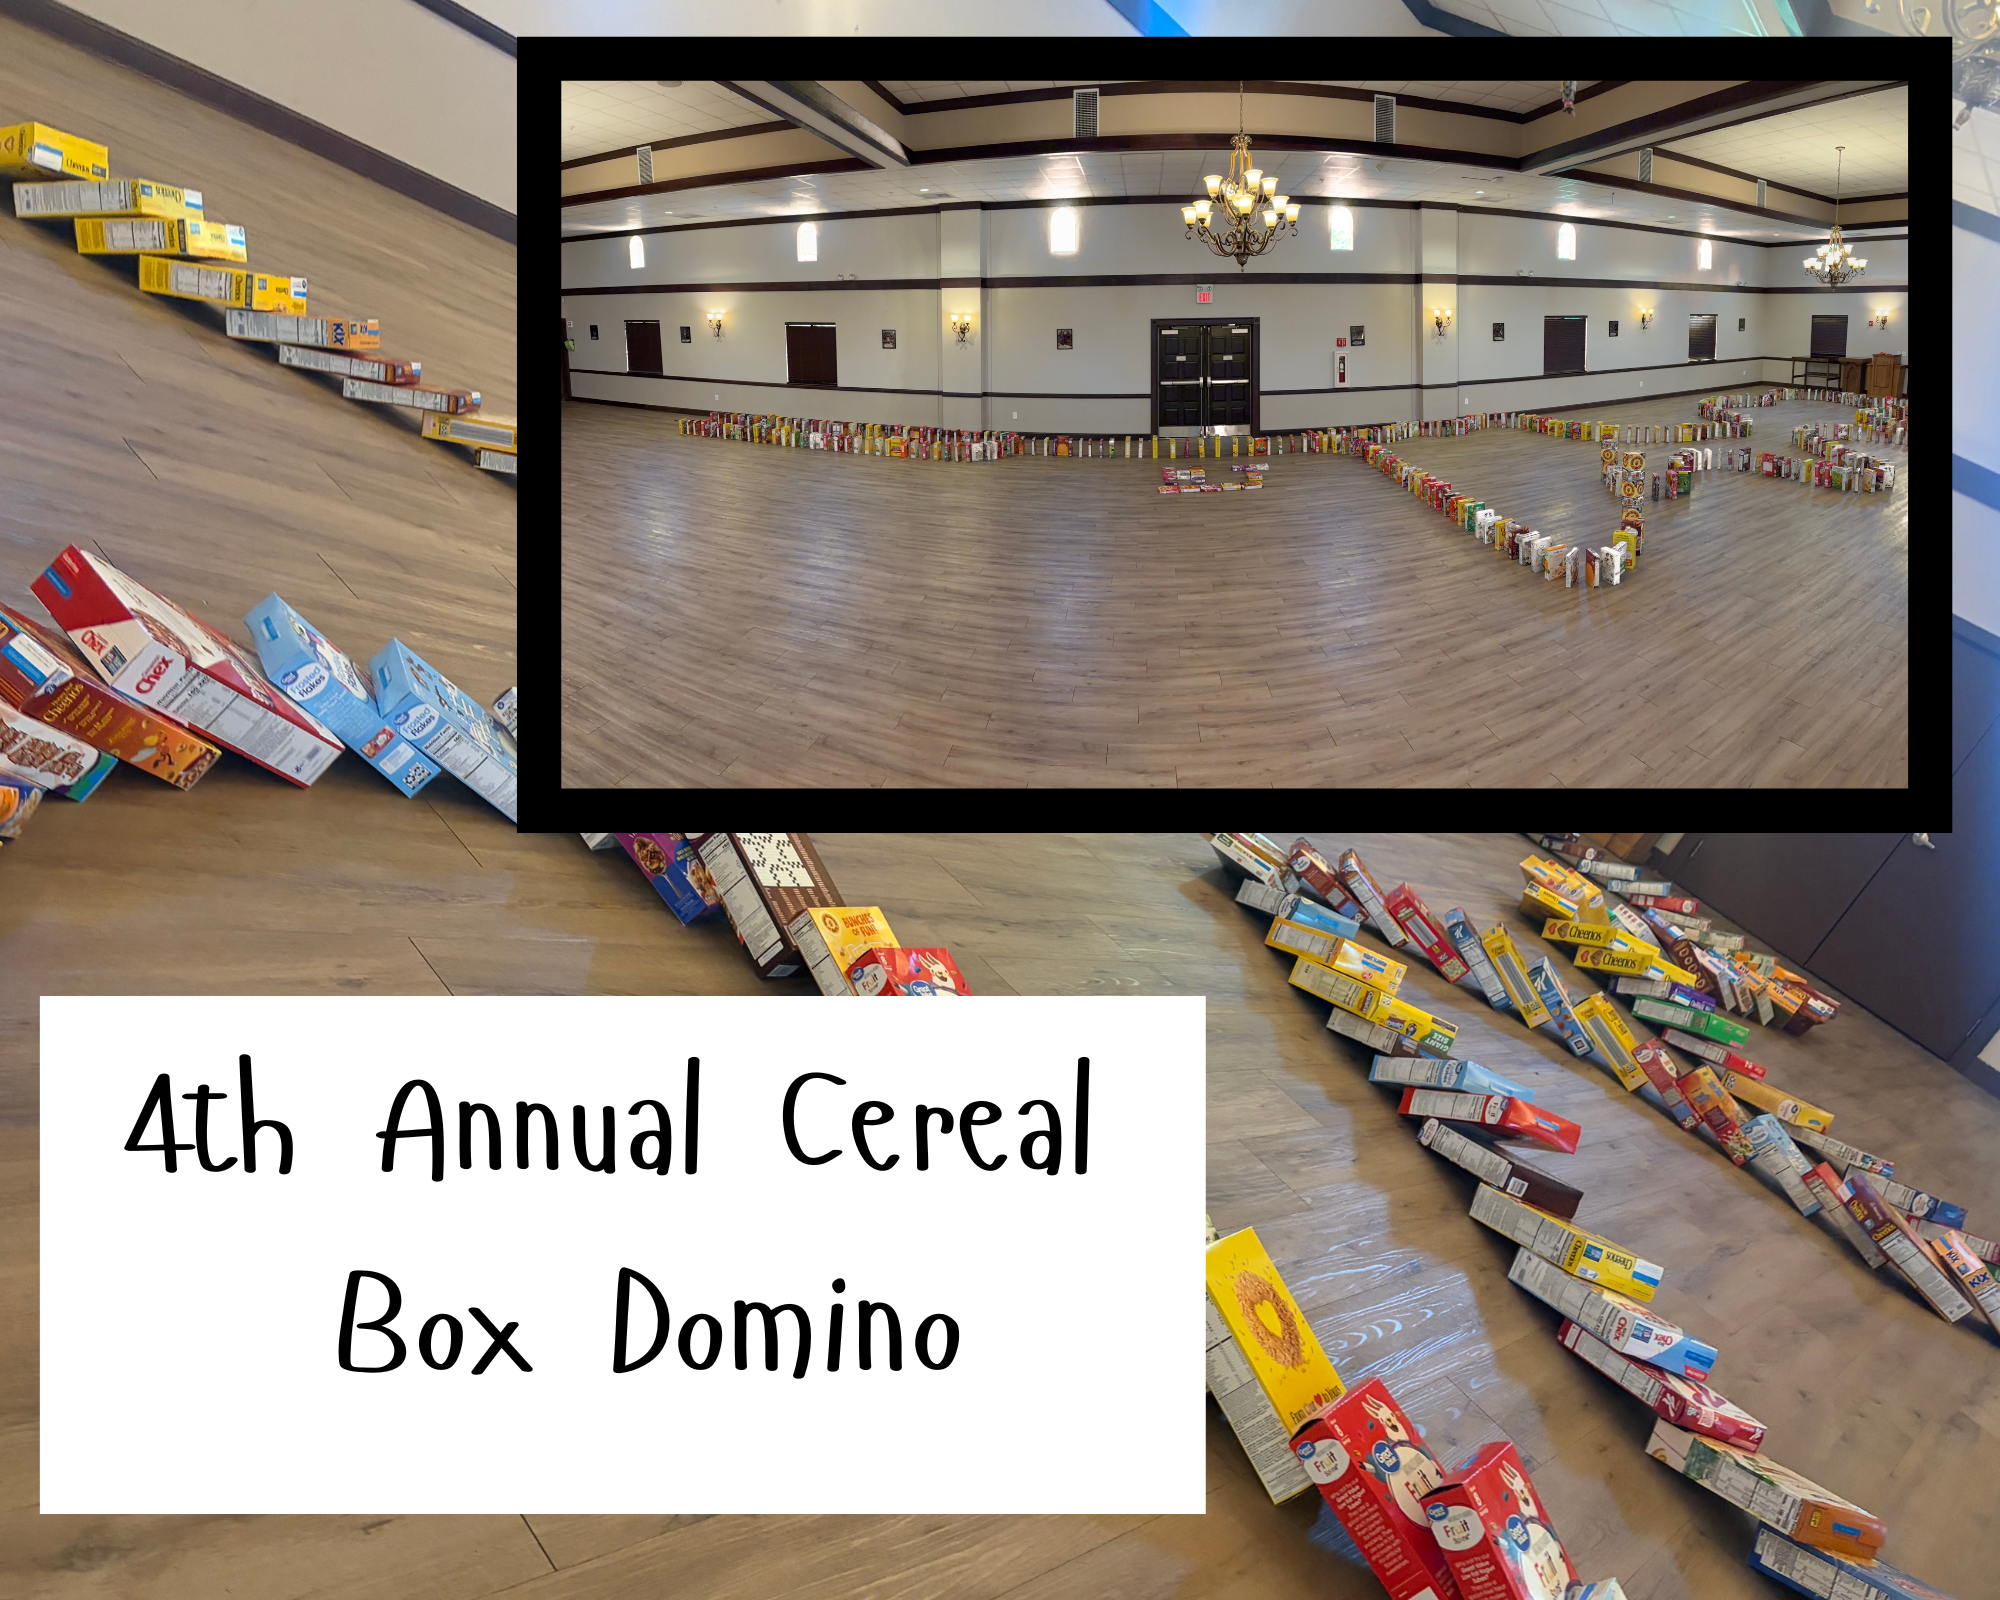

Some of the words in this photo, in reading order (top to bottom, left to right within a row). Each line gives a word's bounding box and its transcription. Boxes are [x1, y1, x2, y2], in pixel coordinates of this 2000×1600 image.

[1198, 292, 1211, 303] EXIT
[136, 655, 174, 695] Chex
[290, 665, 321, 694] Frosted
[299, 674, 326, 698] Flakes
[43, 683, 84, 722] Cheerios
[403, 706, 431, 734] Frosted
[410, 714, 436, 737] Flakes
[841, 912, 875, 929] BUNCHES
[861, 925, 879, 938] FUN!
[1569, 925, 1602, 941] Cheerios
[1602, 953, 1638, 969] Cheerios
[861, 972, 879, 991] Fruit
[1424, 1036, 1449, 1052] GIANT
[1432, 1031, 1450, 1044] SIZE
[1567, 1240, 1583, 1267] Cheerios
[1605, 1251, 1633, 1271] Cheerios
[1613, 1316, 1628, 1342] Chex
[1654, 1332, 1674, 1346] Chex
[1290, 1408, 1306, 1425] From
[1322, 1391, 1328, 1404] to
[1326, 1385, 1342, 1402] Yours
[1314, 1451, 1338, 1472] Fruit
[1443, 1520, 1470, 1537] Fruit
